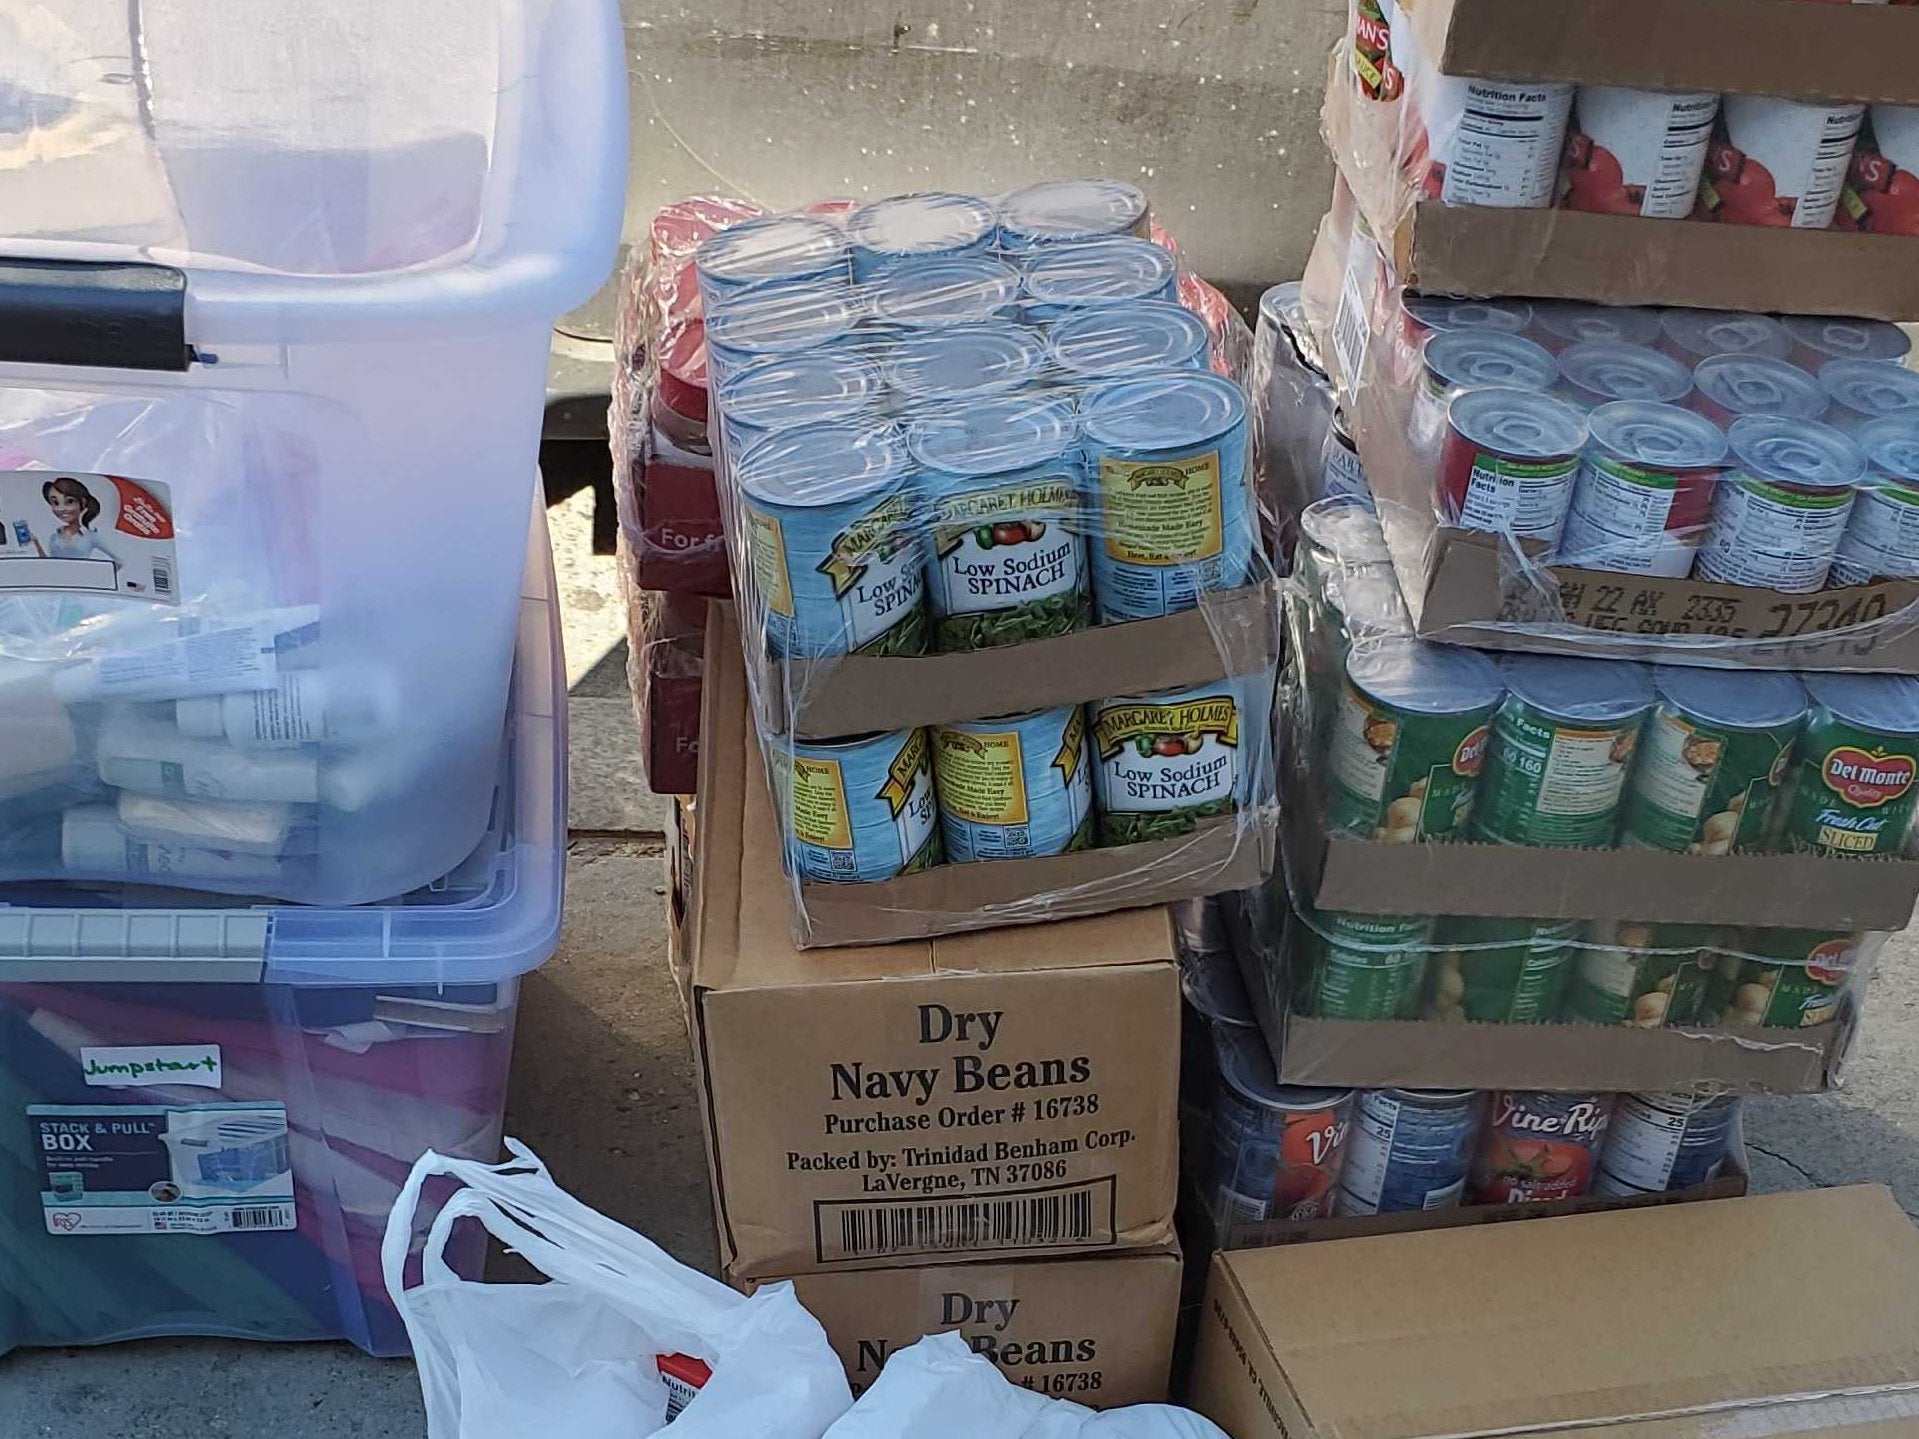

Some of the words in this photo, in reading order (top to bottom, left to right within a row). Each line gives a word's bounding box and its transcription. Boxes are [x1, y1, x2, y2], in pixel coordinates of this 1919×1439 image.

[1468, 84, 1516, 102] Nutrition
[1520, 93, 1547, 102] Facts
[953, 557, 995, 577] Low
[1004, 543, 1071, 576] Sodium
[857, 576, 897, 604] Low
[968, 560, 1065, 595] SPINACH
[1104, 709, 1174, 732] MARGARET
[1180, 704, 1231, 725] HOLMES
[1516, 718, 1551, 739] Facts
[1114, 761, 1153, 783] Low
[1161, 755, 1227, 783] Sodium
[1519, 757, 1542, 774] 160
[1830, 759, 1857, 780] Del
[1858, 768, 1911, 785] Monte
[1127, 771, 1221, 799] SPINACH
[1816, 809, 1857, 829] Fresh
[1823, 829, 1875, 850] SLICED
[1337, 917, 1395, 934] Nutrition
[917, 1003, 1005, 1051] Dry
[84, 1055, 218, 1079] Jumpstart
[830, 1062, 941, 1106] Navy
[953, 1054, 1091, 1094] Beans
[825, 1109, 931, 1135] Purchase
[938, 1105, 1006, 1129] Order
[1012, 1101, 1026, 1123] #
[1033, 1094, 1100, 1120] 16738
[1494, 1091, 1560, 1133] Vine
[1667, 1116, 1685, 1128] 25
[41, 1122, 90, 1134] STACK
[95, 1123, 108, 1134] &
[1376, 1126, 1391, 1139] 25
[42, 1133, 93, 1152] BOX
[787, 1150, 860, 1172] Packed
[867, 1151, 898, 1173] by:
[901, 1141, 989, 1168] Trinidad
[994, 1137, 1079, 1162] Benham
[1084, 1128, 1137, 1150] Corp.
[862, 1170, 967, 1195] LaVergne,
[971, 1167, 1002, 1187] TN
[1006, 1159, 1068, 1183] 37086
[940, 1292, 1021, 1332] Dry
[1042, 1371, 1103, 1393] 16738
